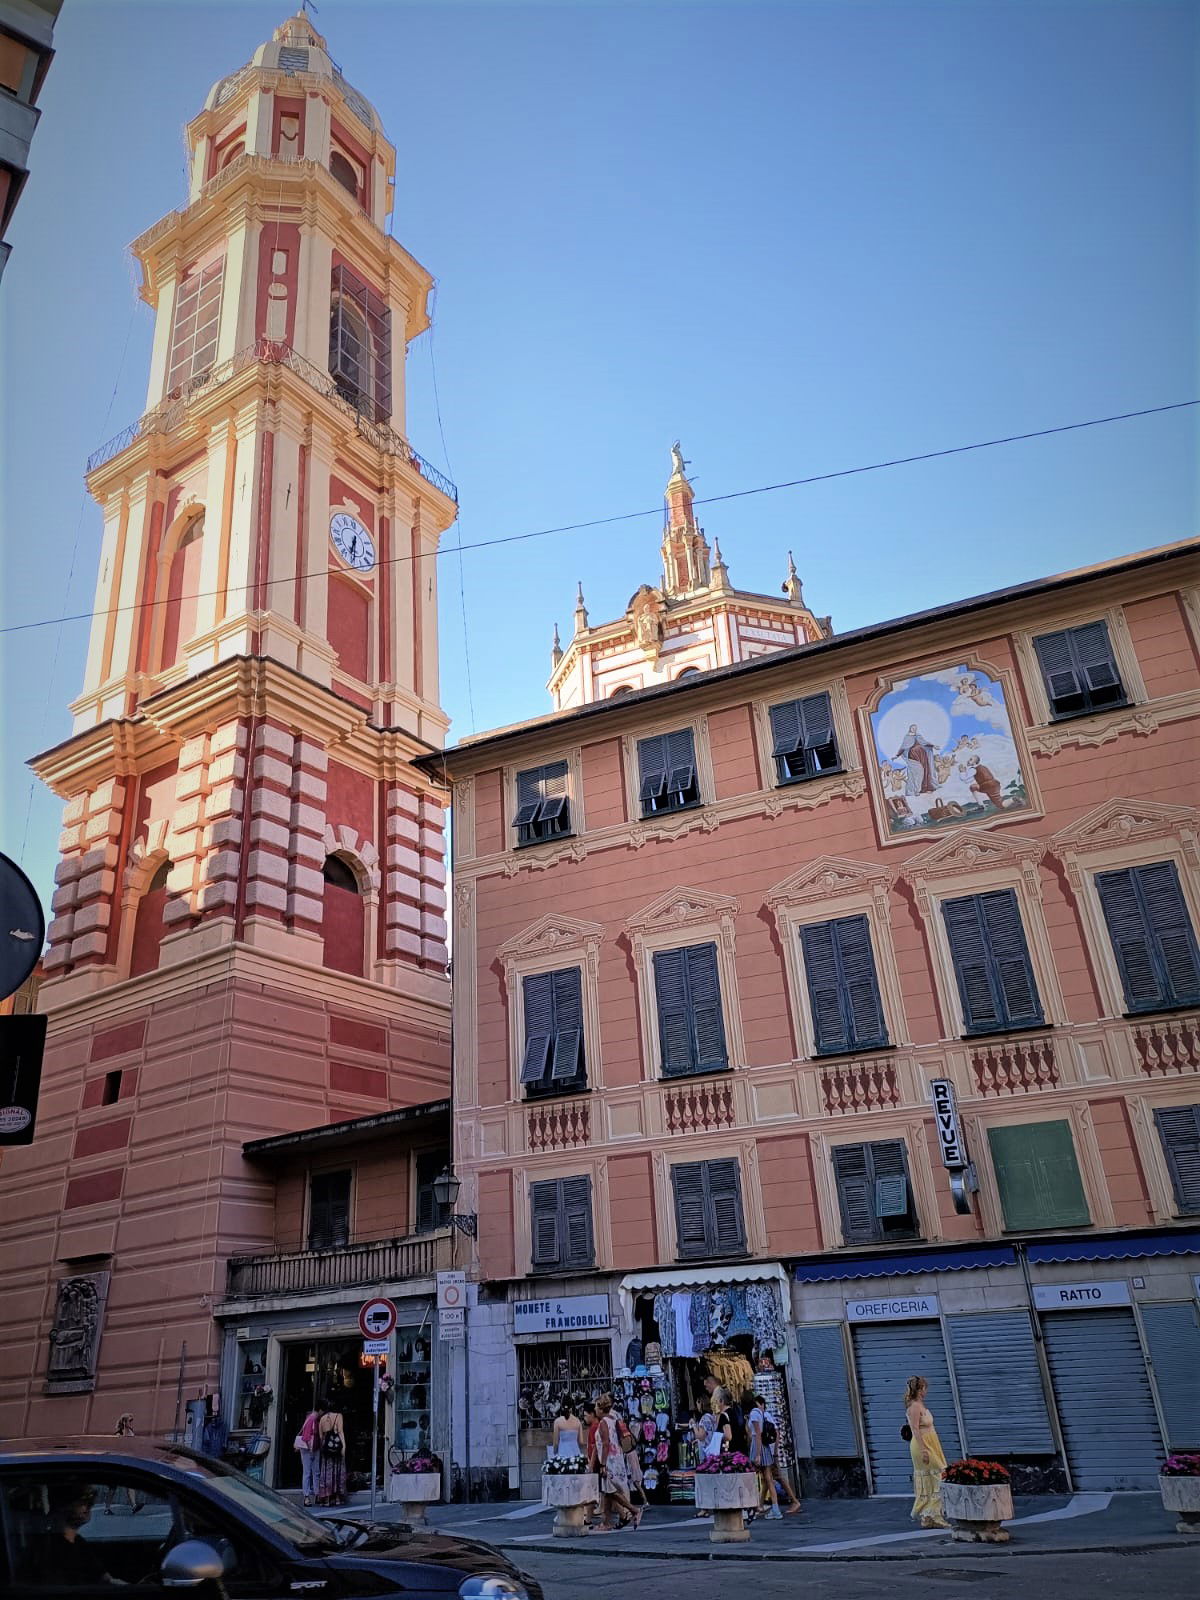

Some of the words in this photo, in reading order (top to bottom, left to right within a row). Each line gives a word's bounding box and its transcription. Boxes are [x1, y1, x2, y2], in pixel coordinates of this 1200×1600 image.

[933, 1084, 959, 1161] REVUE
[1060, 1287, 1102, 1301] RATTO
[515, 1302, 550, 1315] MONETE
[556, 1304, 564, 1314] &
[855, 1300, 929, 1316] OREFICERIA
[545, 1313, 608, 1328] FRANCOBOLLI
[290, 1580, 328, 1590] SPORT
